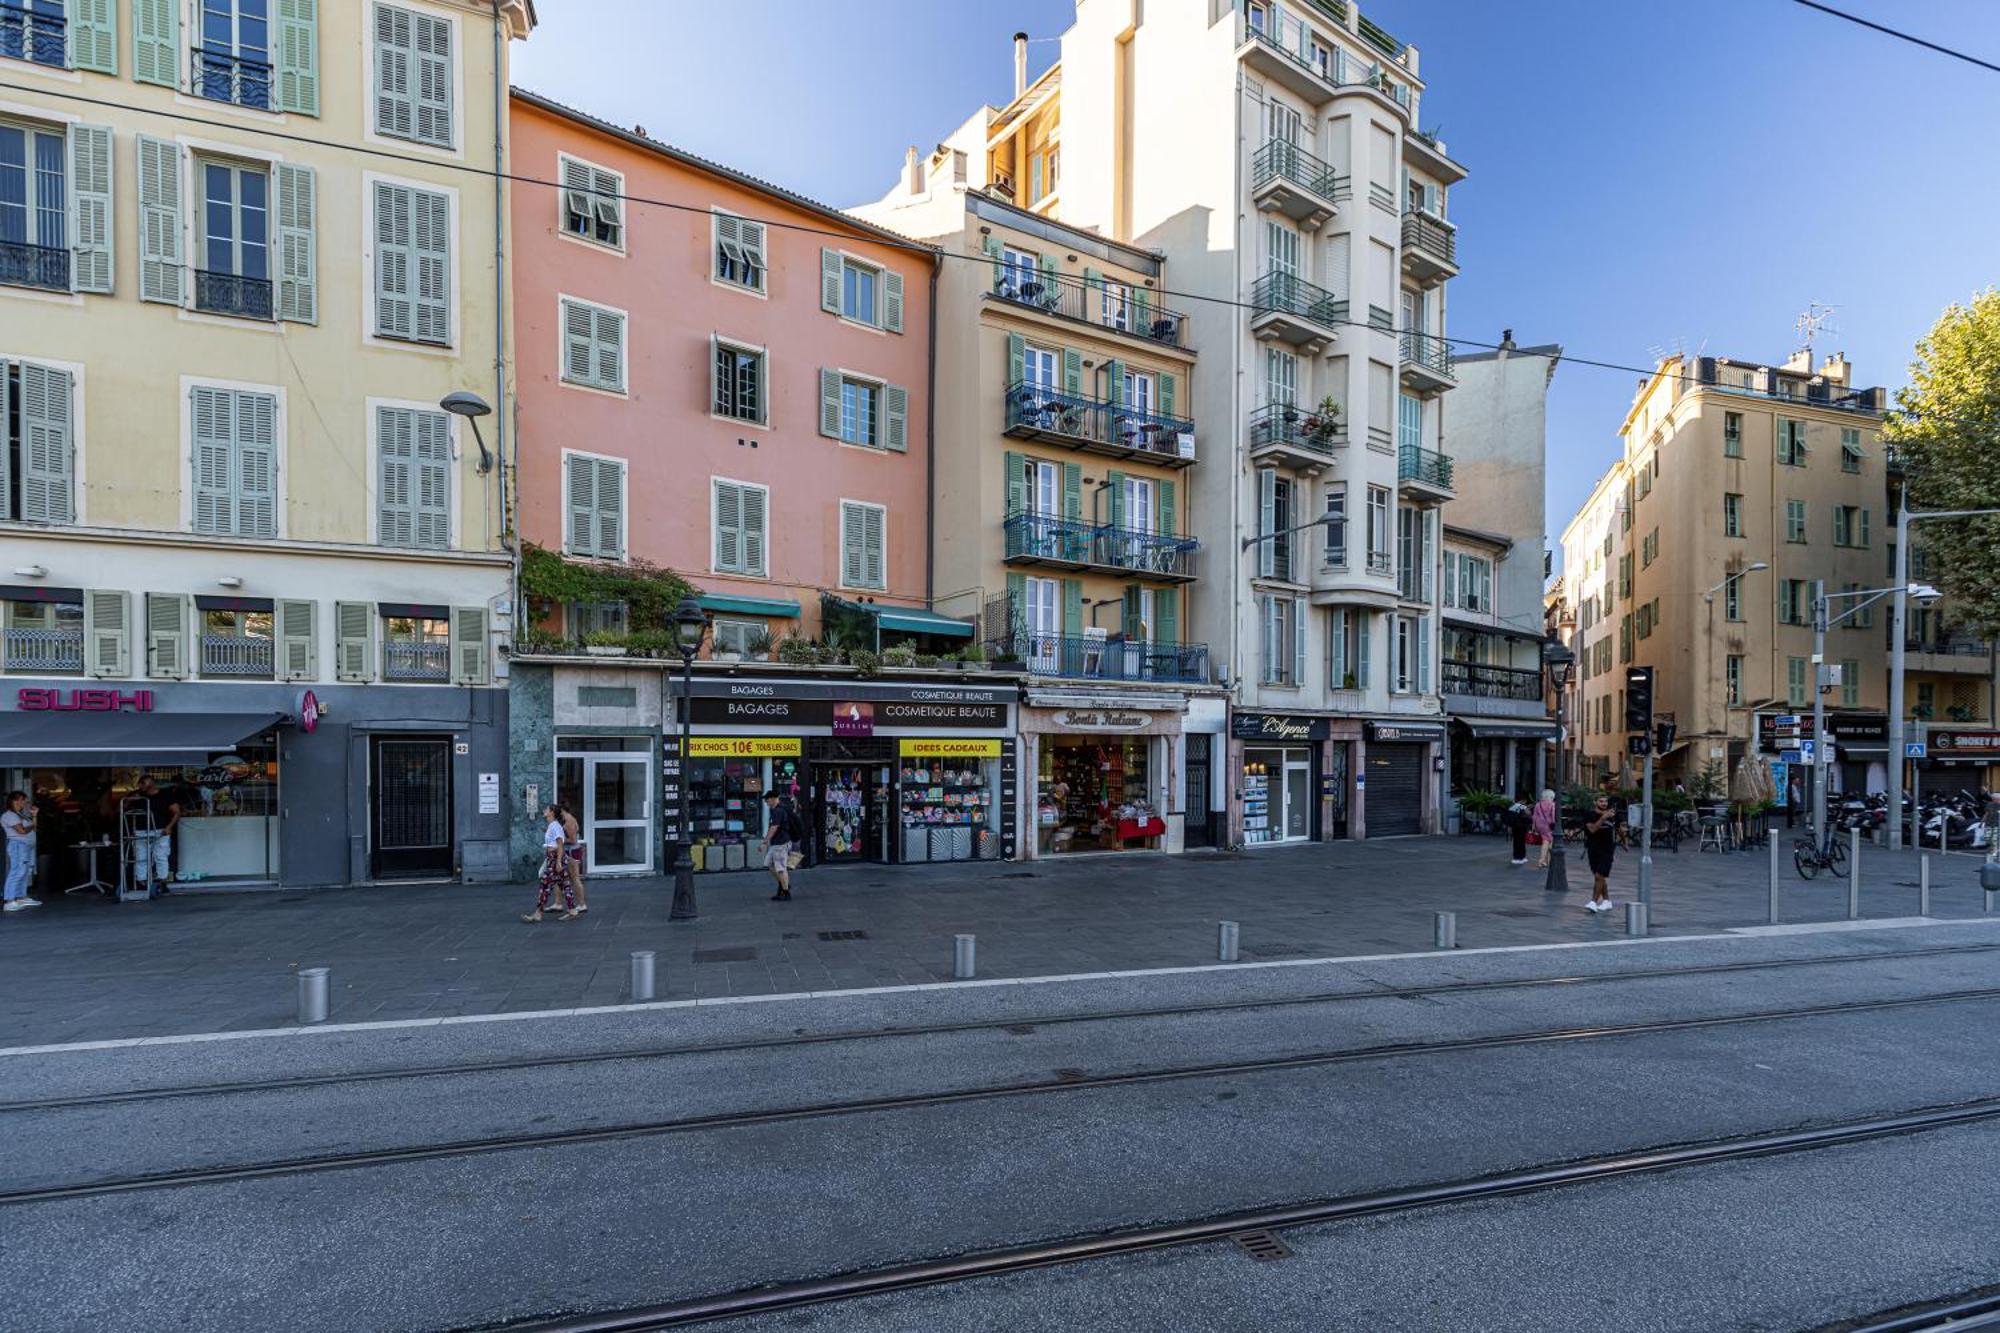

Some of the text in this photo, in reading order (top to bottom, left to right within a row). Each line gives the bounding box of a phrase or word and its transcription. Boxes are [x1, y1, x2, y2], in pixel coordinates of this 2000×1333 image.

[731, 686, 774, 696] BAGAGES
[911, 690, 993, 701] COSMETIQUE BEAUTE
[18, 688, 152, 711] SUSHI
[728, 703, 789, 715] BAGAGES
[886, 705, 997, 718] COSMETIQUE BEAUTE
[689, 741, 797, 753] RIX CHOCS 10€ TOUS LES SACS
[914, 744, 988, 752] IDEES CADEAUX
